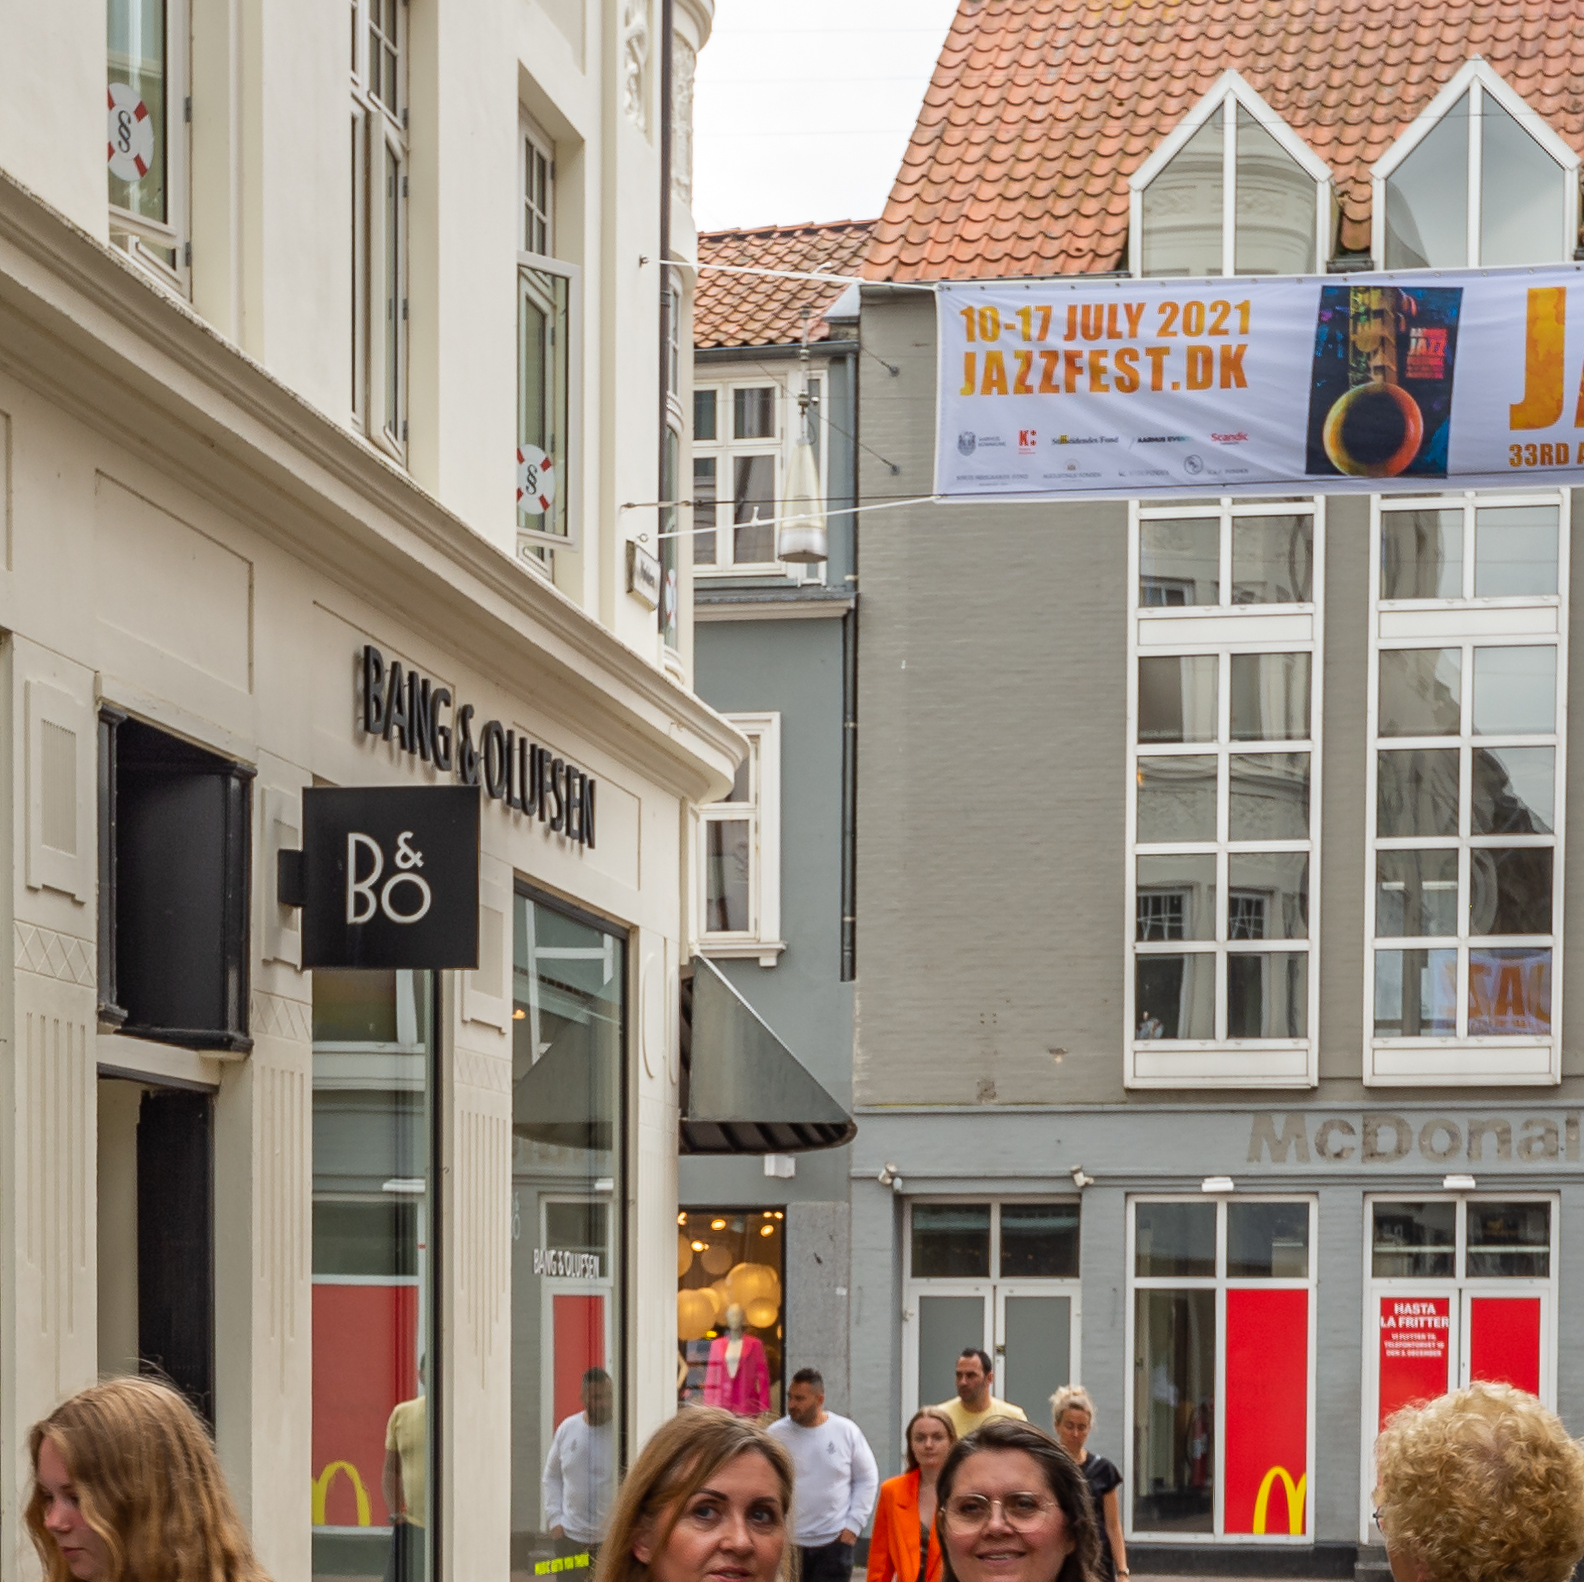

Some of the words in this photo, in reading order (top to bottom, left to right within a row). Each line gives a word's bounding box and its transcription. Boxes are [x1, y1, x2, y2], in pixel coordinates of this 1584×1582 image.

[960, 304, 1052, 342] 10-17
[1063, 302, 1146, 341] JULY
[1156, 300, 1251, 337] 2021
[960, 343, 1249, 396] JAZZFEST.DK
[1509, 442, 1569, 468] 33RD
[363, 645, 452, 772] BANG
[458, 704, 480, 786] &
[482, 719, 595, 849] OLUFSEN
[1380, 1315, 1396, 1328] LA
[1398, 1315, 1449, 1328] FRITTER
[1394, 1302, 1437, 1315] HASTA
